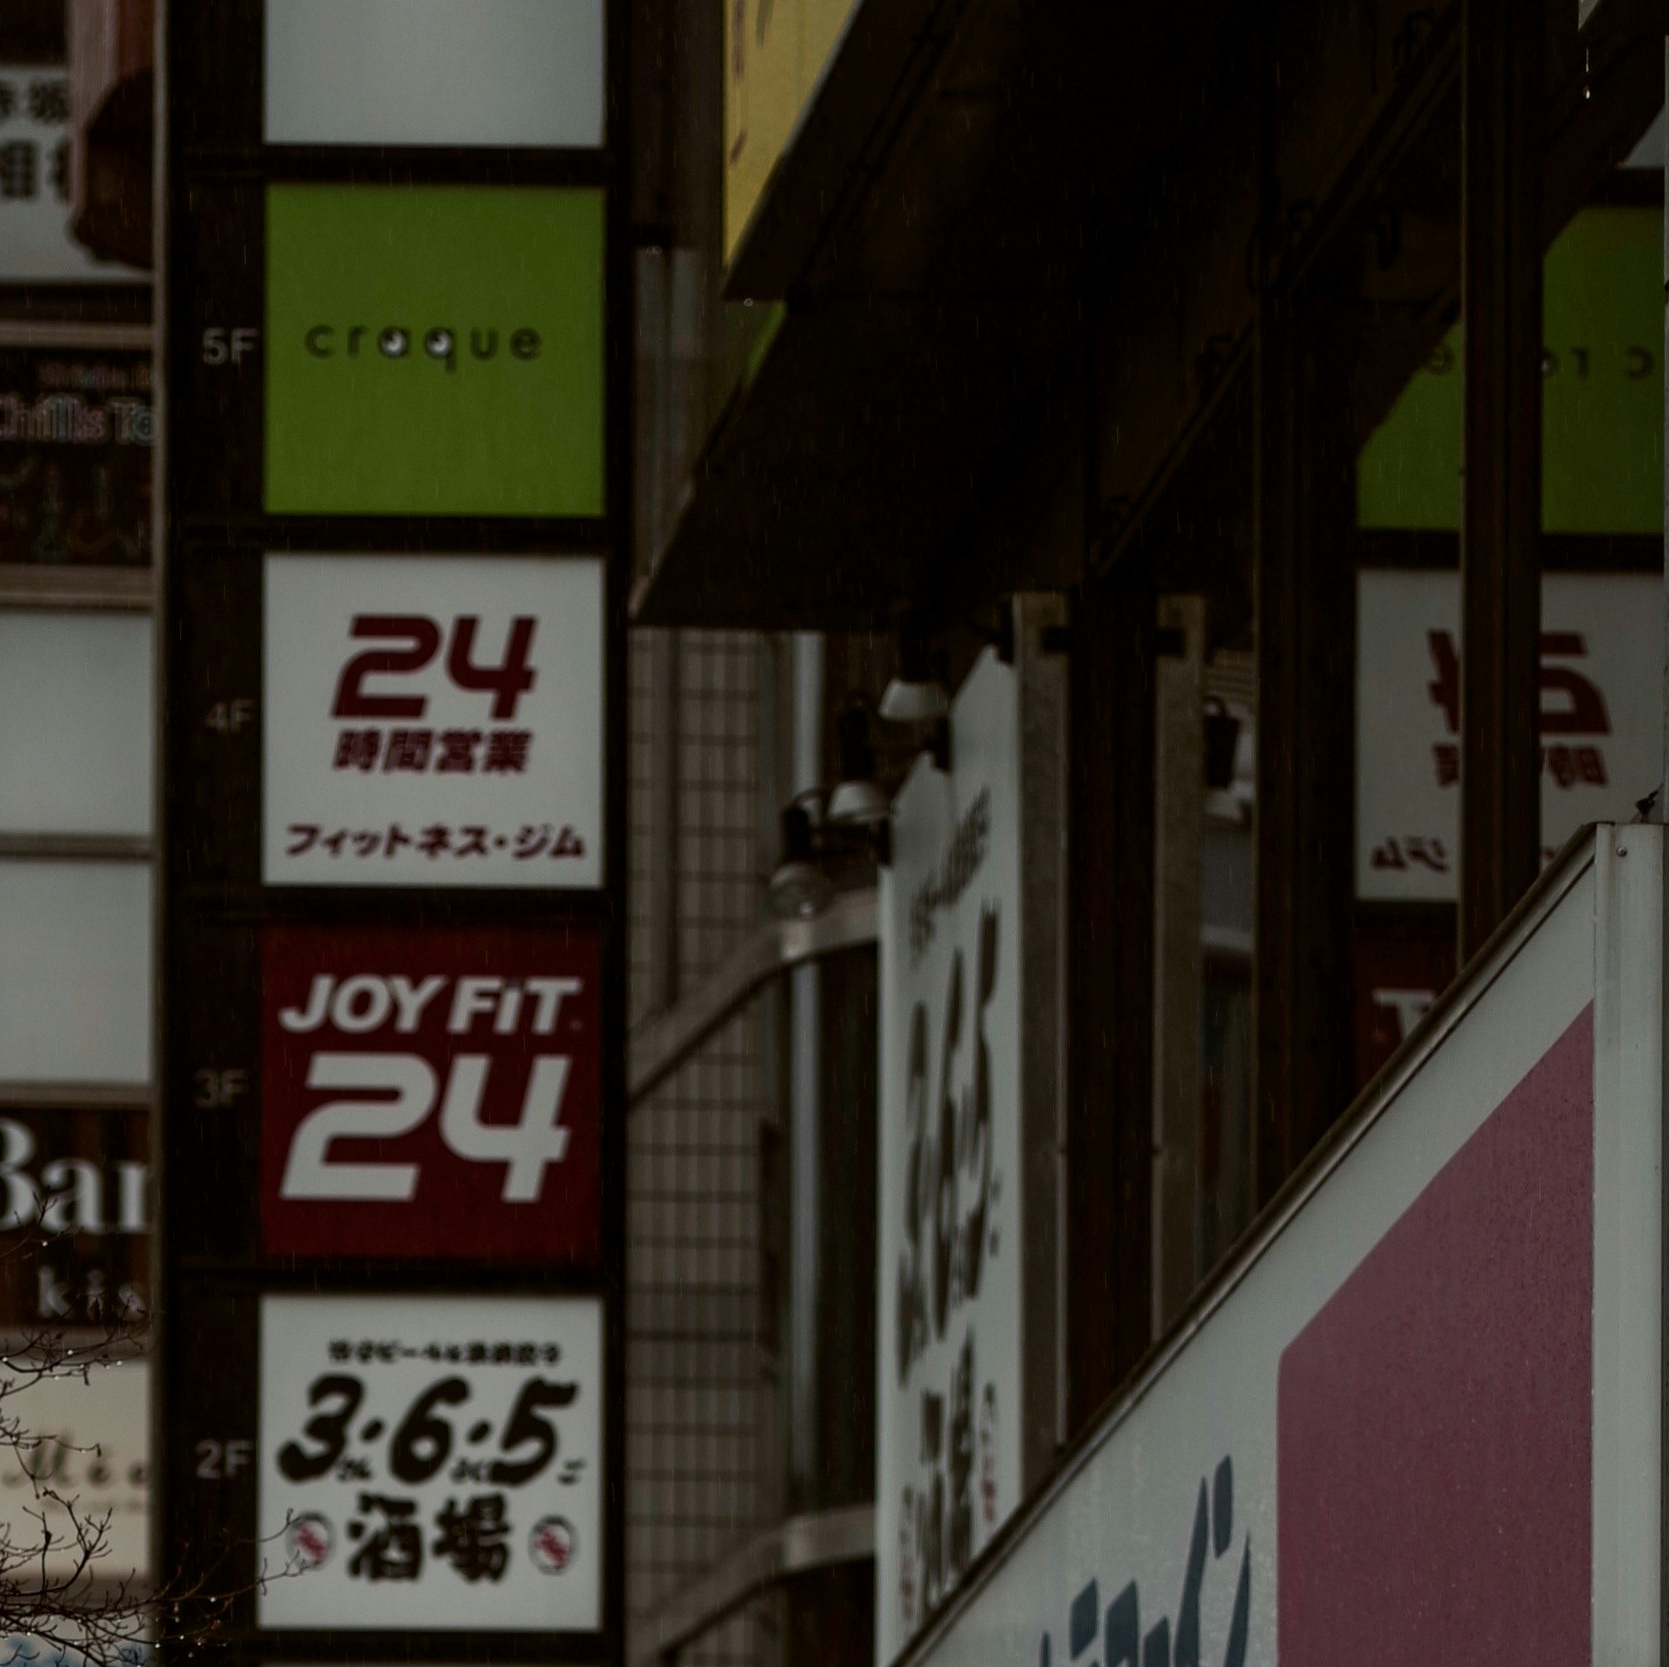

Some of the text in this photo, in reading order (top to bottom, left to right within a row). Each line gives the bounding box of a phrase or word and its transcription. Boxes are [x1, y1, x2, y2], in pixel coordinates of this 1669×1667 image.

[202, 326, 259, 367] 5F
[333, 613, 537, 719] 24
[204, 700, 254, 734] 4F
[334, 730, 532, 773] 時間営業
[285, 823, 585, 858] フィットネス・ジム
[193, 1066, 250, 1109] 3F
[277, 1049, 574, 1204] 24
[195, 1439, 254, 1481] 2F
[347, 1493, 510, 1584] 酒場
